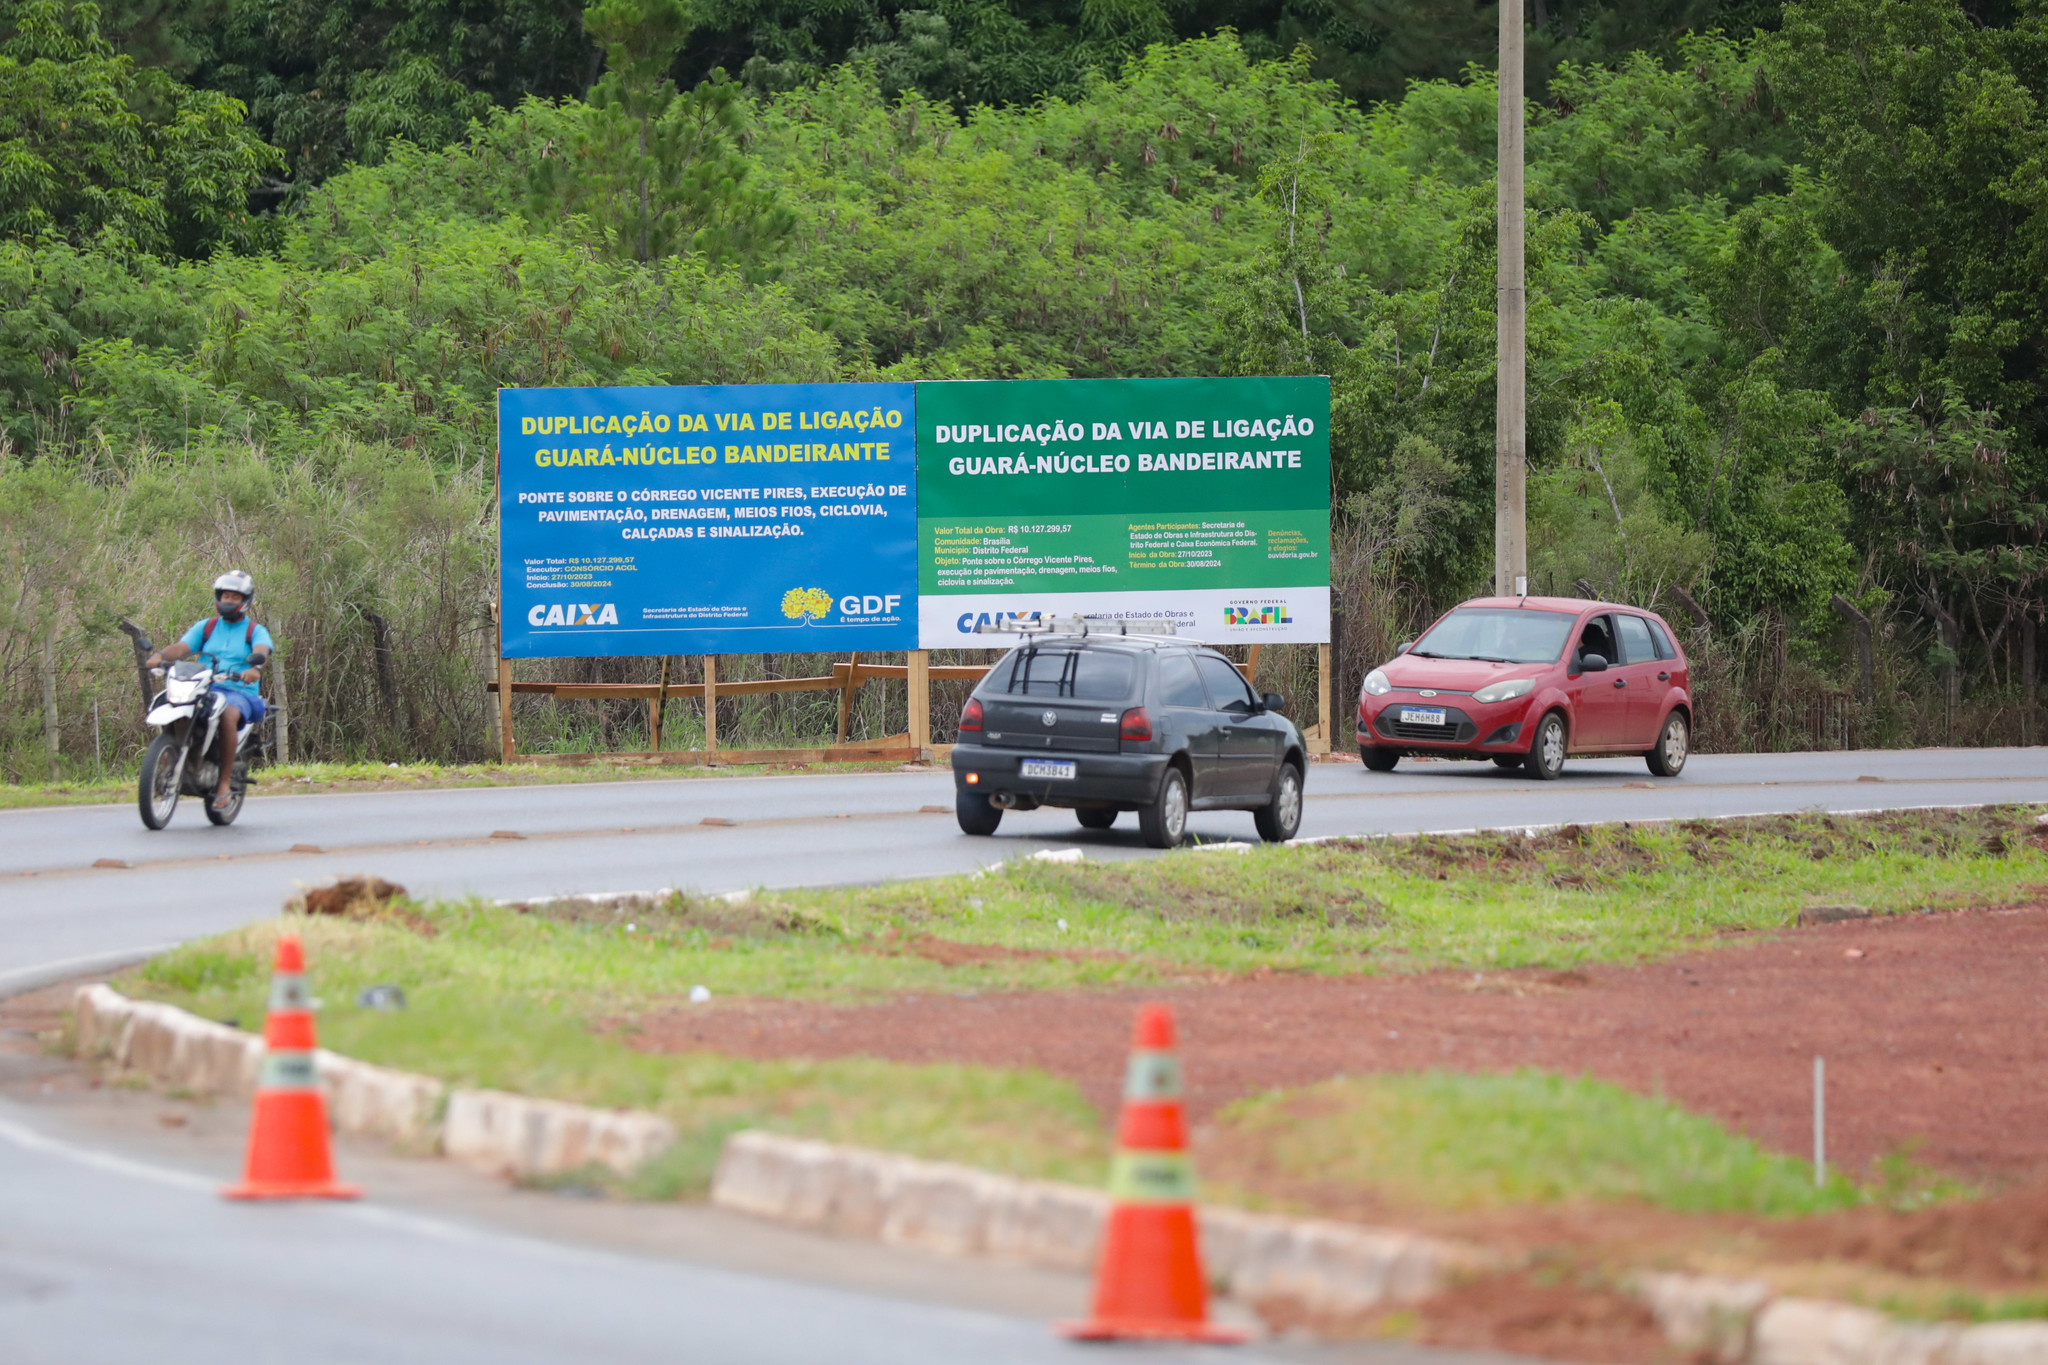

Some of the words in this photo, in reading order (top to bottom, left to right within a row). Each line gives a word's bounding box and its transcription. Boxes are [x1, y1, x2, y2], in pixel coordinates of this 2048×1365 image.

[522, 412, 670, 437] DUPLICAÇÃO
[678, 415, 709, 433] DA
[714, 414, 754, 431] VIA
[762, 413, 792, 430] DE
[800, 407, 902, 433] LIGAÇÃO
[936, 420, 1084, 446] DUPLICAÇÃO
[1092, 422, 1122, 440] DA
[1129, 421, 1168, 439] VIA
[1176, 420, 1205, 438] DE
[1213, 415, 1314, 442] LIGAÇÃO
[535, 444, 716, 467] GUARÁ-NÚCLEO
[725, 442, 889, 463] BANDEIRANTE
[949, 452, 1130, 475] GUARÁ-NÚCLEO
[1138, 450, 1302, 472] BANDEIRANTE
[519, 490, 564, 503] PONTE
[568, 490, 613, 503] SOBRE
[618, 490, 627, 502] O
[631, 487, 696, 502] CÓRREGO
[701, 487, 760, 500] VICENTE
[764, 487, 807, 501] PIRES,
[811, 483, 885, 501] EXECUÇÃO
[889, 485, 906, 496] DE
[538, 506, 647, 524] PAVIMENTAÇÃO,
[652, 507, 730, 521] DRENAGEM,
[734, 506, 778, 519] MEIOS
[782, 505, 816, 519] FIOS,
[820, 504, 887, 518] CICLOVIA,
[622, 526, 694, 542] CALÇADAS
[698, 527, 706, 538] E
[710, 522, 804, 539] SINALIZAÇÃO.
[1008, 525, 1018, 534] R$
[1020, 525, 1071, 533] 10.127.299,57
[935, 547, 971, 555] Município:
[935, 557, 961, 566] Objeto:
[1013, 556, 1043, 565] Córrego
[1074, 556, 1094, 564] Pires,
[938, 568, 972, 577] execução
[984, 567, 1037, 576] pavimentação,
[1039, 566, 1077, 575] drenagem,
[1102, 565, 1117, 574] fios,
[973, 577, 1014, 586] sinalização.
[528, 604, 619, 626] CAIXA
[840, 595, 901, 615] GDF
[1224, 606, 1292, 624] BRASIL
